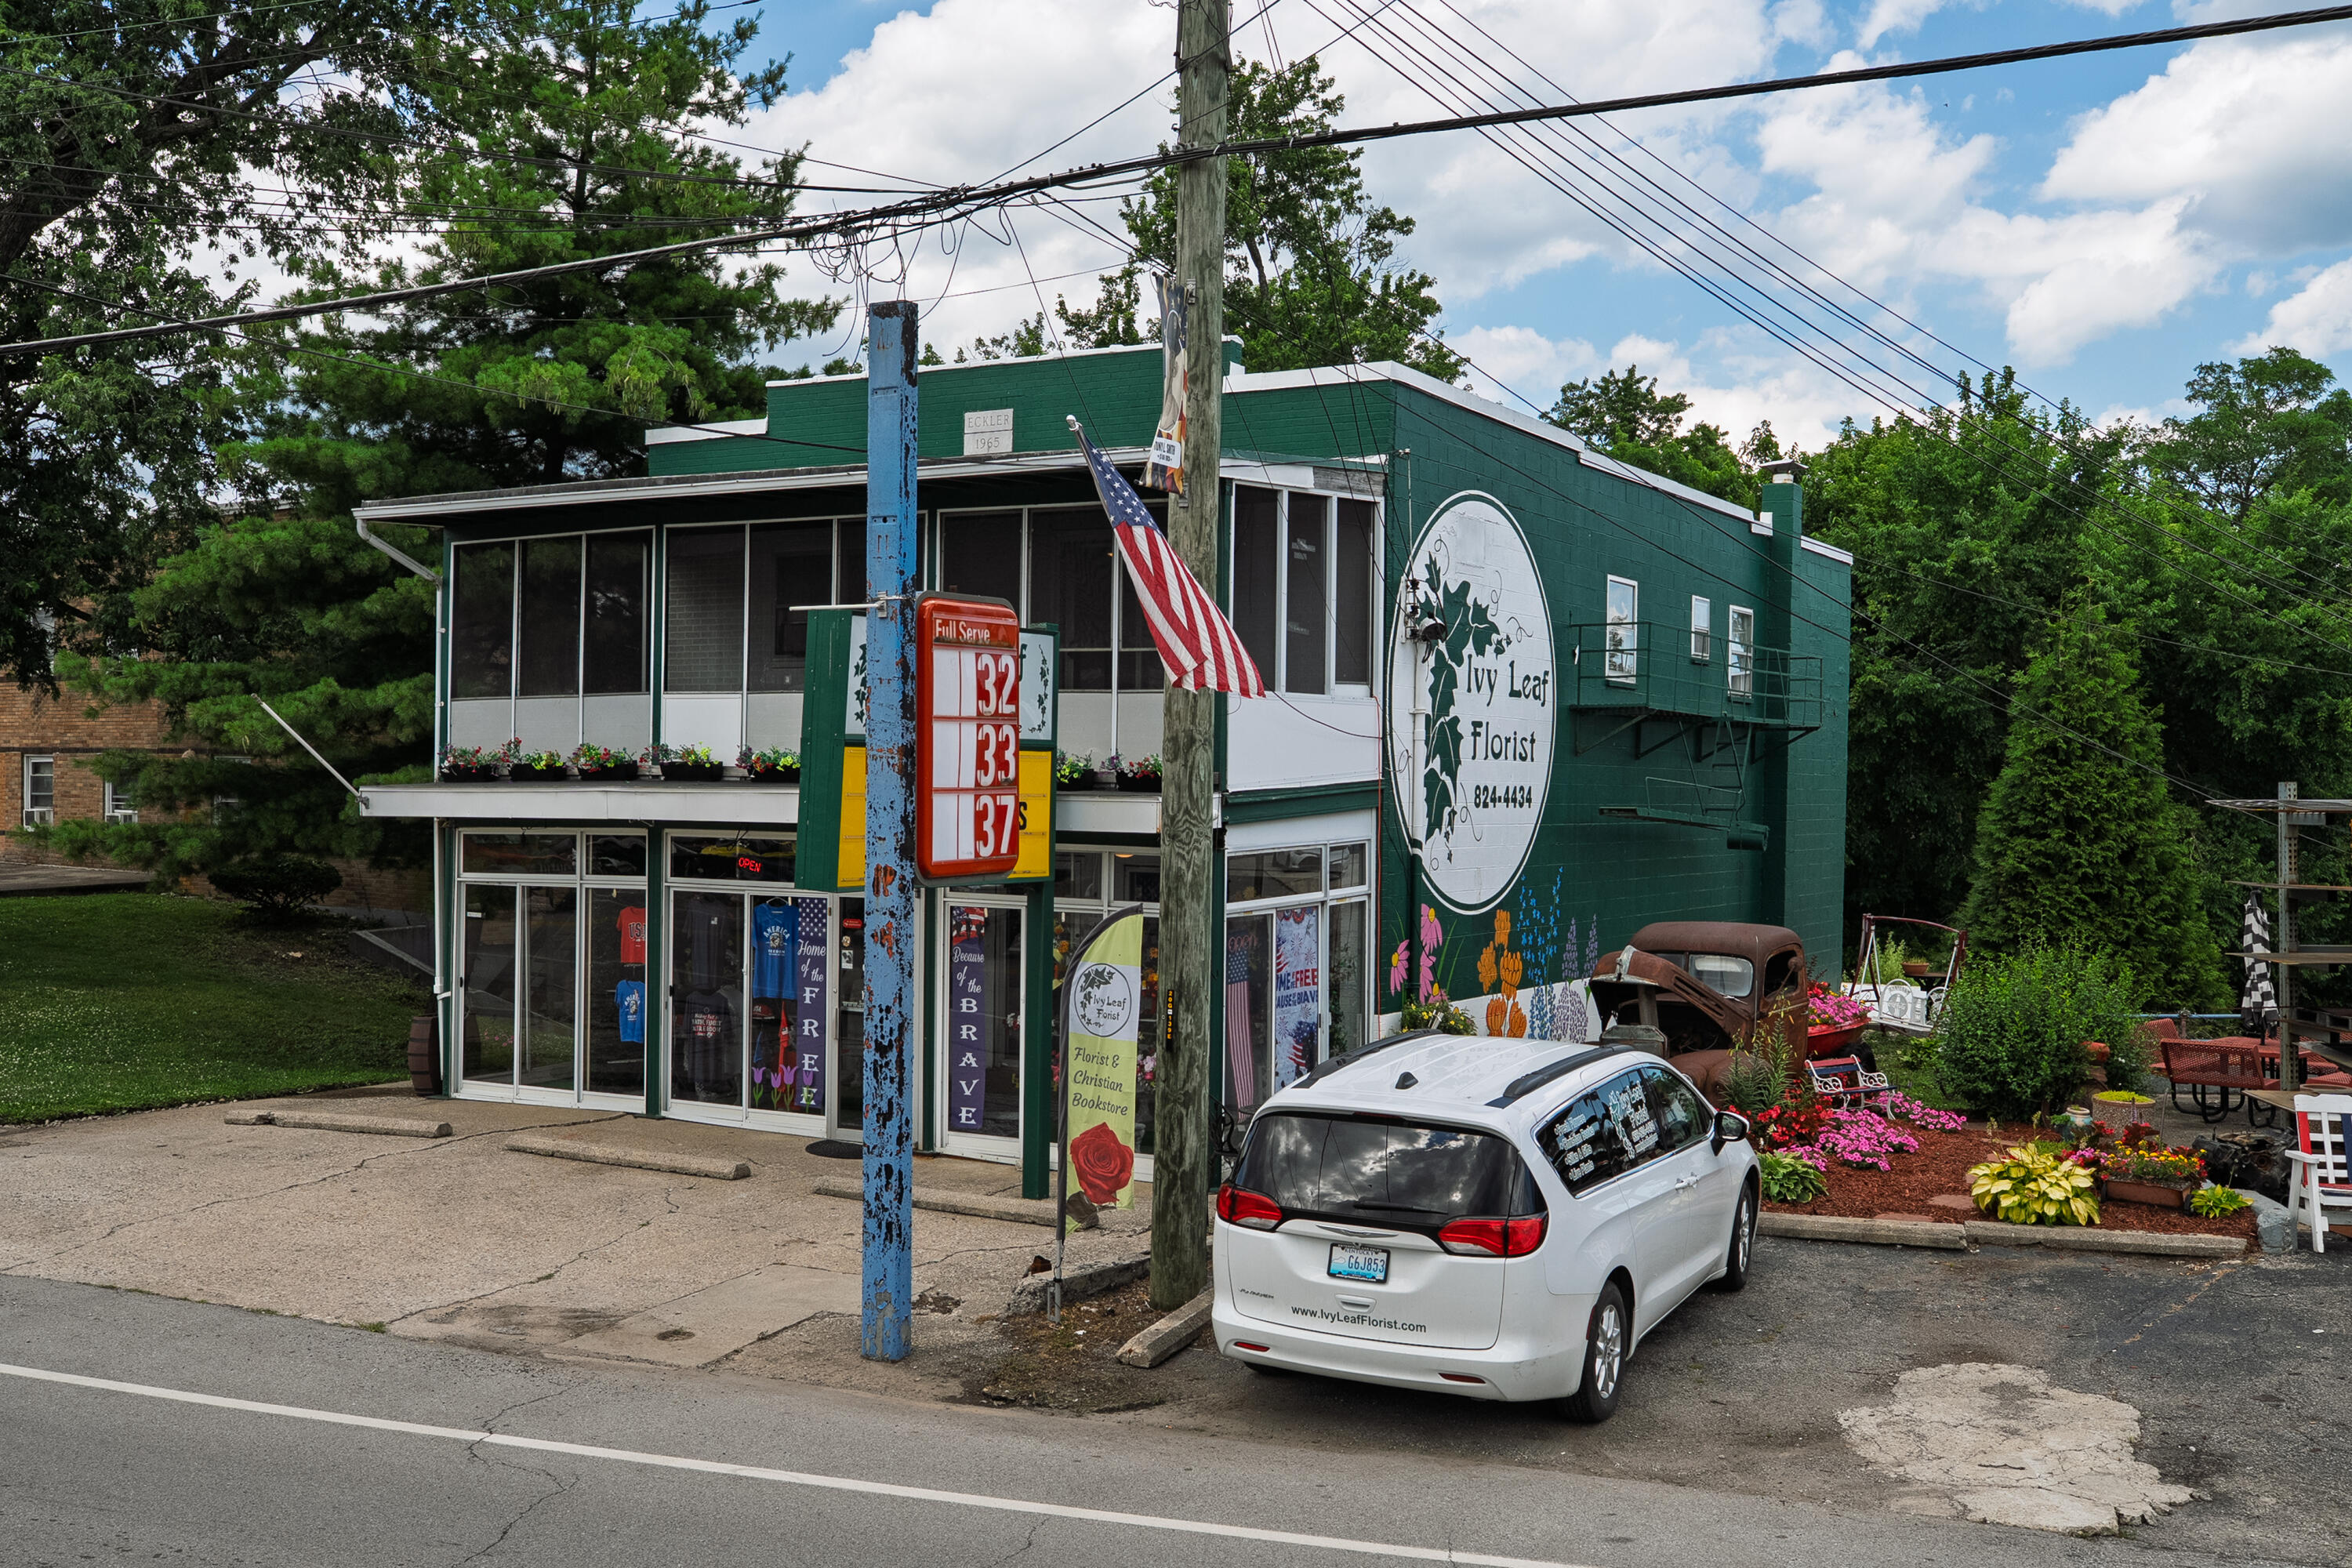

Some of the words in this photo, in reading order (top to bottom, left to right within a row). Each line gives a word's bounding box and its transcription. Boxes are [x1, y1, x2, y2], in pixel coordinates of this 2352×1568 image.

[968, 414, 1010, 428] ECKLER
[976, 437, 1000, 449] 1965
[935, 619, 956, 640] Full
[958, 621, 991, 644] Serve
[977, 653, 1016, 716] 32
[1466, 654, 1497, 706] Ivy
[1508, 660, 1549, 706] Leaf
[1471, 720, 1536, 762] Florist
[977, 724, 1015, 787] 33
[1474, 784, 1532, 808] 824-4434
[976, 795, 1015, 858] 37
[739, 857, 761, 873] OPEN
[763, 926, 790, 940] AMERICA
[797, 939, 826, 956] Home
[953, 946, 985, 963] Because
[801, 958, 811, 978] of
[811, 967, 824, 982] the
[956, 965, 967, 987] of
[967, 978, 982, 993] the
[1276, 973, 1290, 991] ME
[1295, 968, 1318, 989] FREE
[1094, 994, 1105, 1007] Ivy
[1106, 996, 1127, 1011] Leaf
[1276, 993, 1292, 1008] AUSE
[959, 998, 980, 1124] BRAVE
[1074, 1047, 1109, 1066] Florist
[1112, 1054, 1120, 1069] &
[1073, 1069, 1123, 1092] Christian
[1072, 1092, 1128, 1116] Bookstore
[1348, 1255, 1385, 1273] G6J853
[1291, 1306, 1426, 1333] www.IvyLeafFlorist.com
